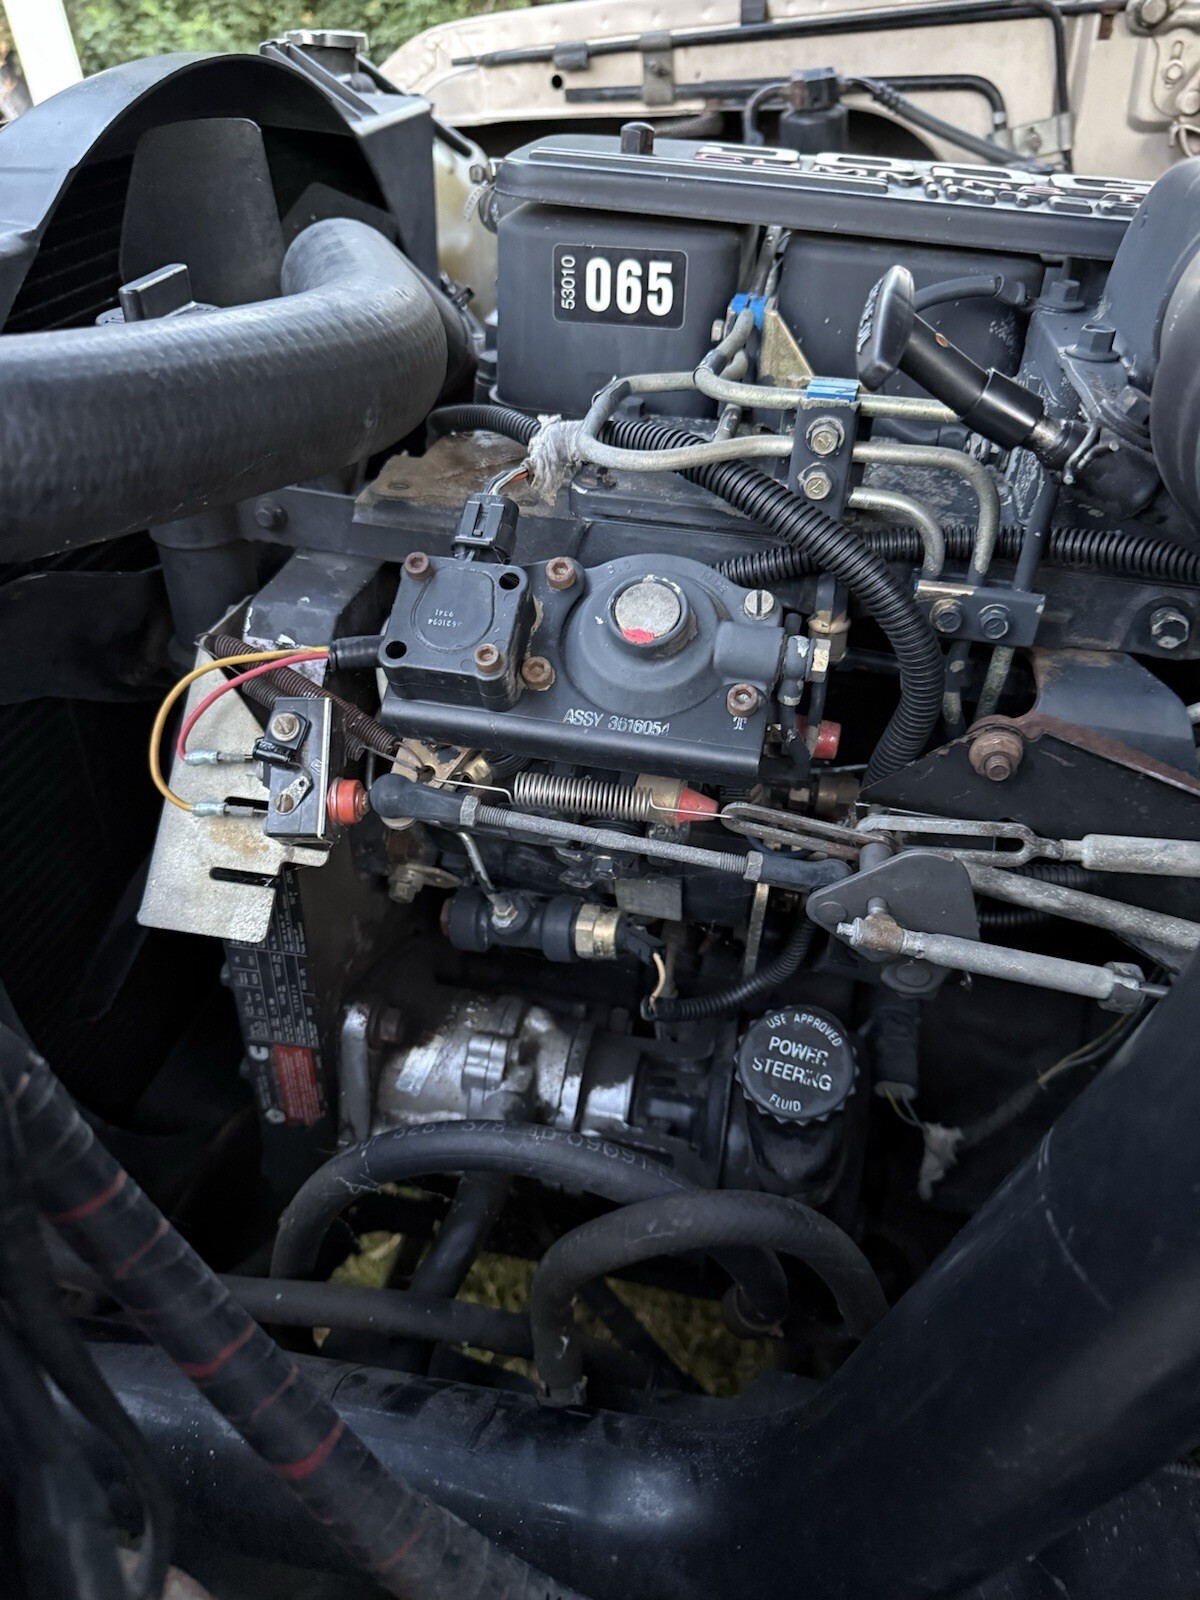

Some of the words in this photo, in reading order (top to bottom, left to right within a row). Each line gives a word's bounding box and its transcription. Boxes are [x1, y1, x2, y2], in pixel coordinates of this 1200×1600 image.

[697, 142, 1154, 195] DODG
[561, 255, 576, 310] 53010
[585, 256, 674, 317] 065
[563, 707, 604, 728] ASSY
[766, 1013, 788, 1029] USE
[793, 1013, 843, 1048] APPROVED
[768, 1036, 830, 1068] POWER
[751, 1057, 833, 1092] STEERING
[768, 1093, 802, 1113] FLUID
